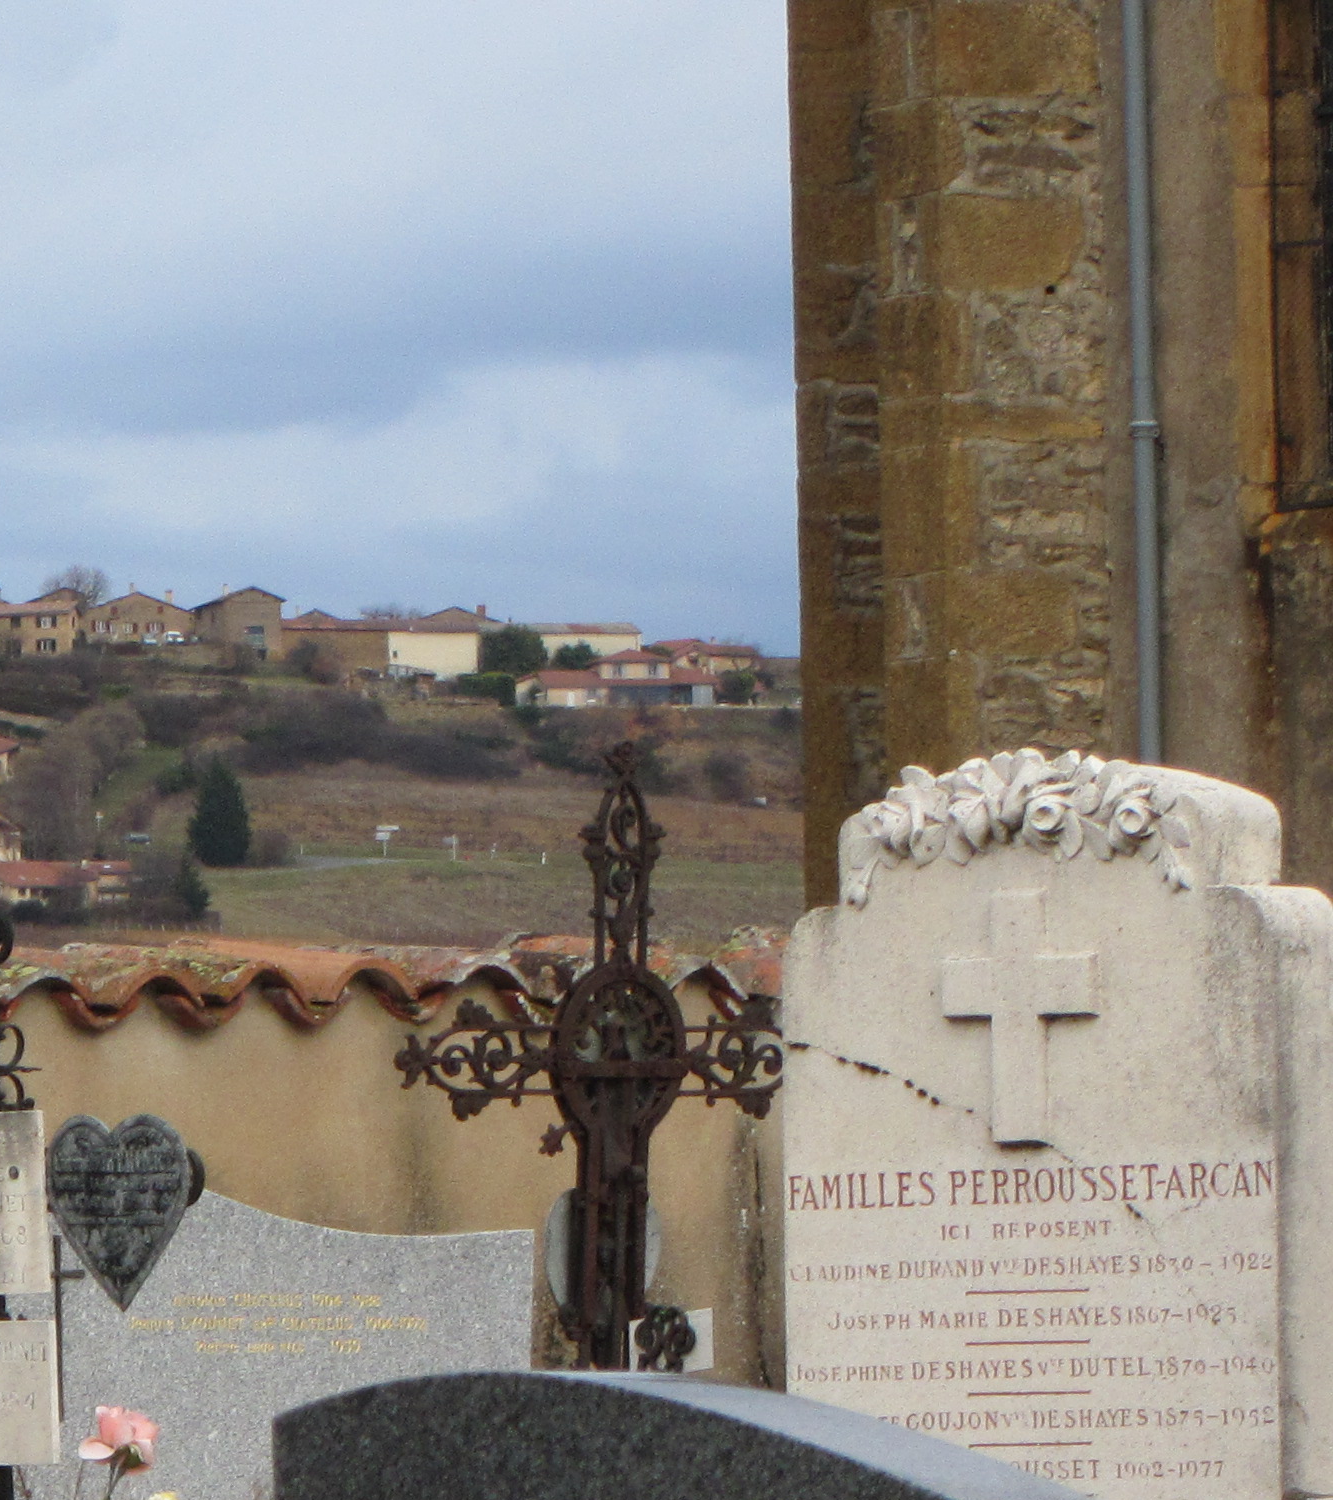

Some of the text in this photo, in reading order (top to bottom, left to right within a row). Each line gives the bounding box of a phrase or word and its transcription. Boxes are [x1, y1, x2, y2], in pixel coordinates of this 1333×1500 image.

[787, 1159, 1274, 1211] FAMILLES PERROUSSET-ARCAN
[940, 1218, 1111, 1241] ICI REPOSENT
[789, 1263, 892, 1282] CLAUDINE
[898, 1258, 984, 1280] DURAND
[1023, 1253, 1141, 1277] DESHAYES
[827, 1311, 911, 1331] JOSEPH
[918, 1310, 988, 1330] MARIE
[997, 1304, 1123, 1328] DESHAYES
[790, 1363, 905, 1383] JOSEPHINE
[911, 1358, 1034, 1382] DESHAYES
[1069, 1356, 1152, 1378] DUTEL
[904, 1410, 999, 1431] GOUJON
[1032, 1407, 1149, 1429] DESHAYES
